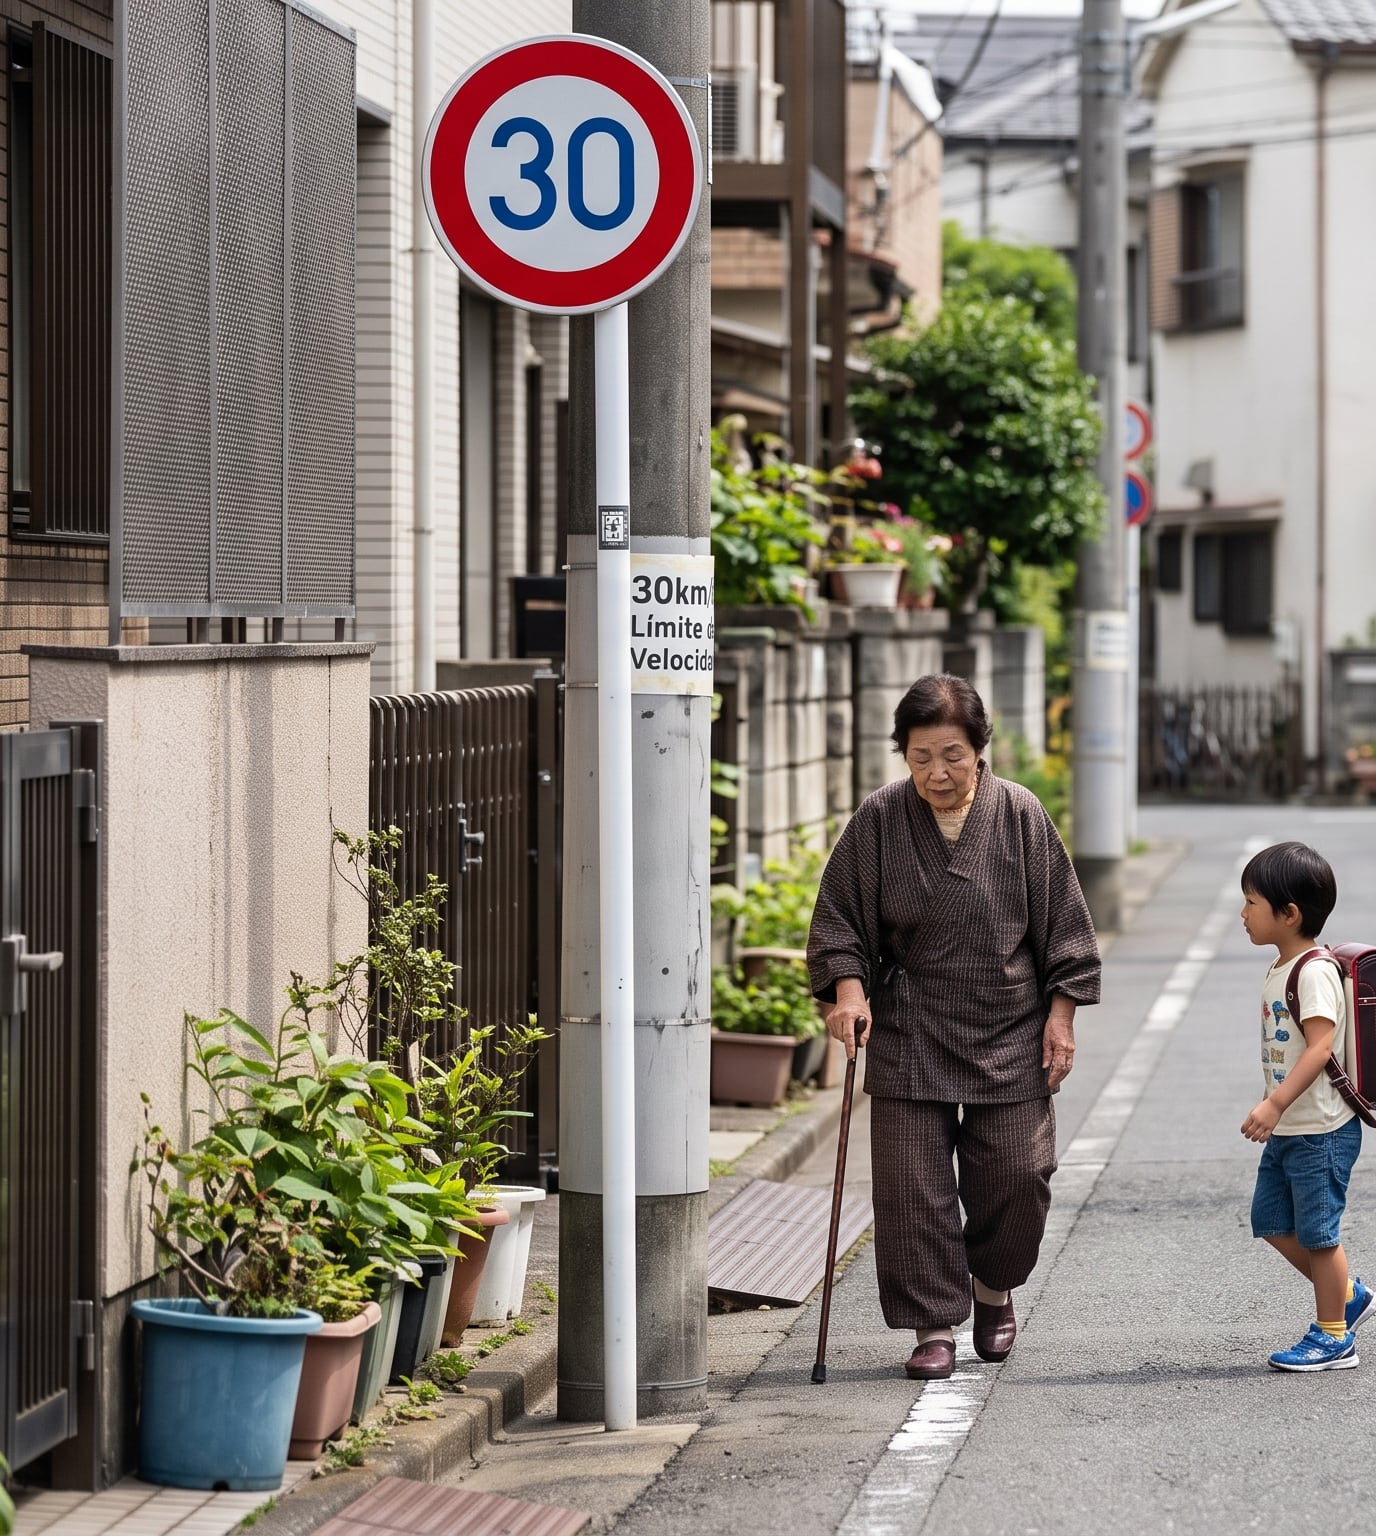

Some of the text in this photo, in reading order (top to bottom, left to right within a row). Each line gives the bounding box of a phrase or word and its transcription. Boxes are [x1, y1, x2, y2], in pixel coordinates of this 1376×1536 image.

[489, 117, 635, 231] 30
[632, 614, 702, 639] Límite
[630, 647, 713, 671] Velocida
